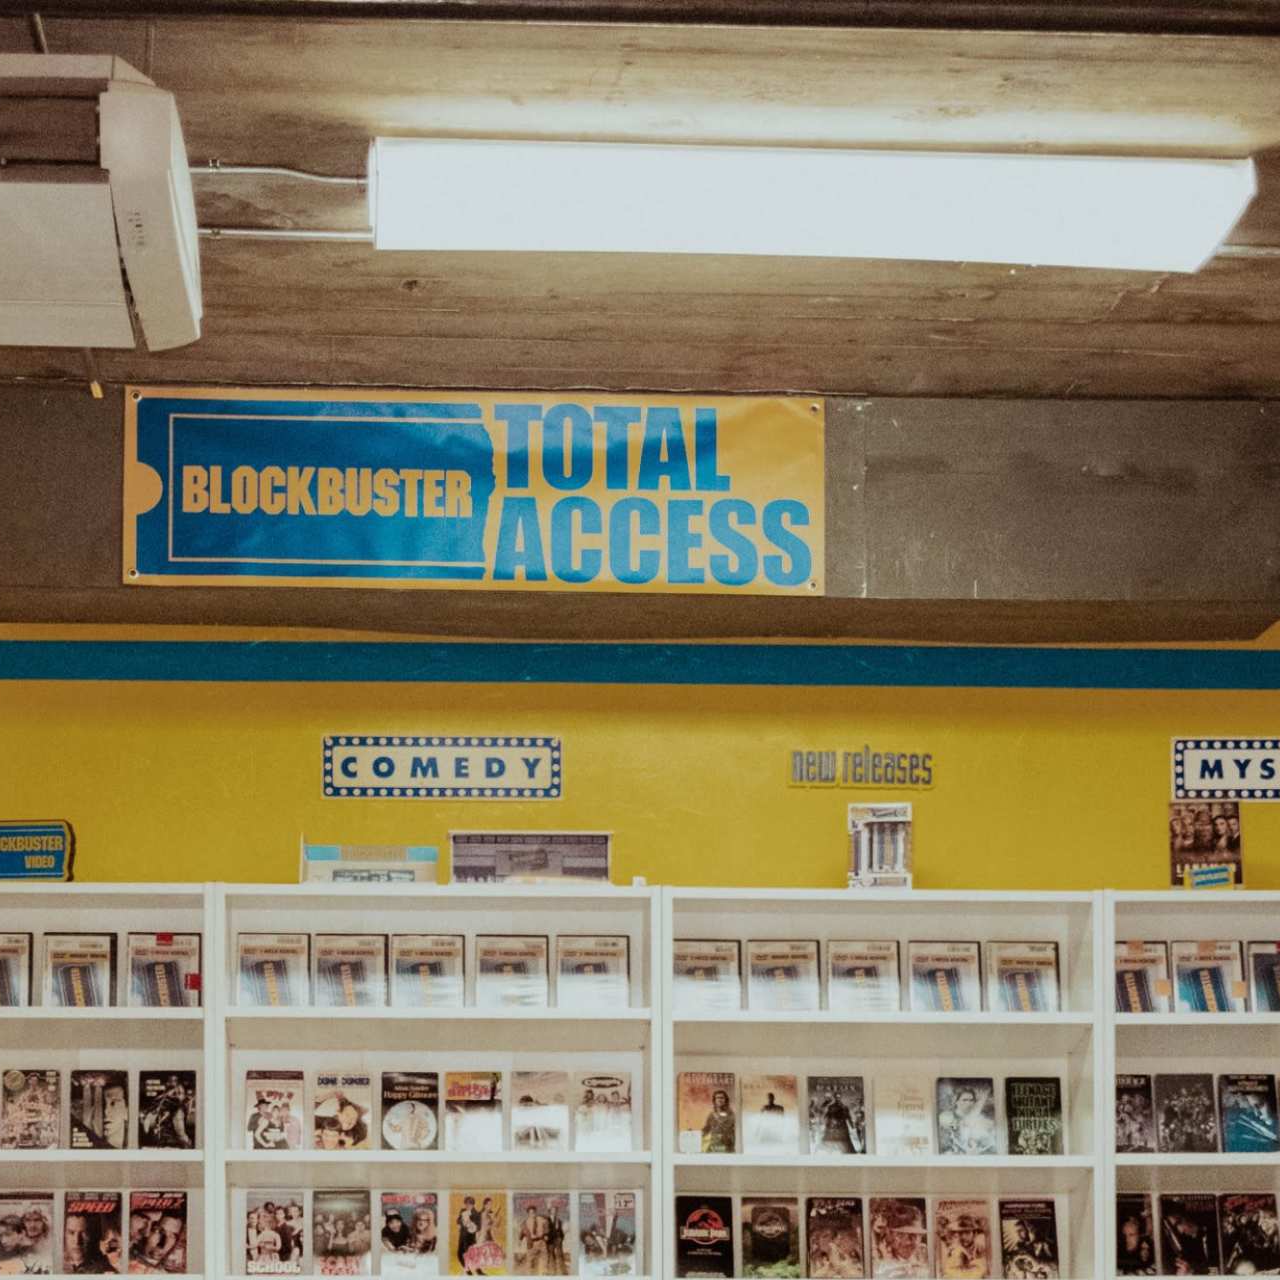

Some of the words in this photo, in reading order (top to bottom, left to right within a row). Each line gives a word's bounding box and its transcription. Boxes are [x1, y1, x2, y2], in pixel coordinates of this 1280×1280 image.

[495, 404, 730, 492] TOTAL
[183, 465, 473, 518] BLOCKBUSTER
[493, 497, 812, 587] ACCESS
[341, 756, 542, 779] COMEDY
[792, 750, 836, 782] new
[842, 744, 932, 783] releases
[24, 855, 55, 868] VIDEO
[1199, 969, 1218, 1012] CKBUSTER
[68, 1202, 115, 1212] SPEED
[248, 1261, 301, 1274] SCHOOL
